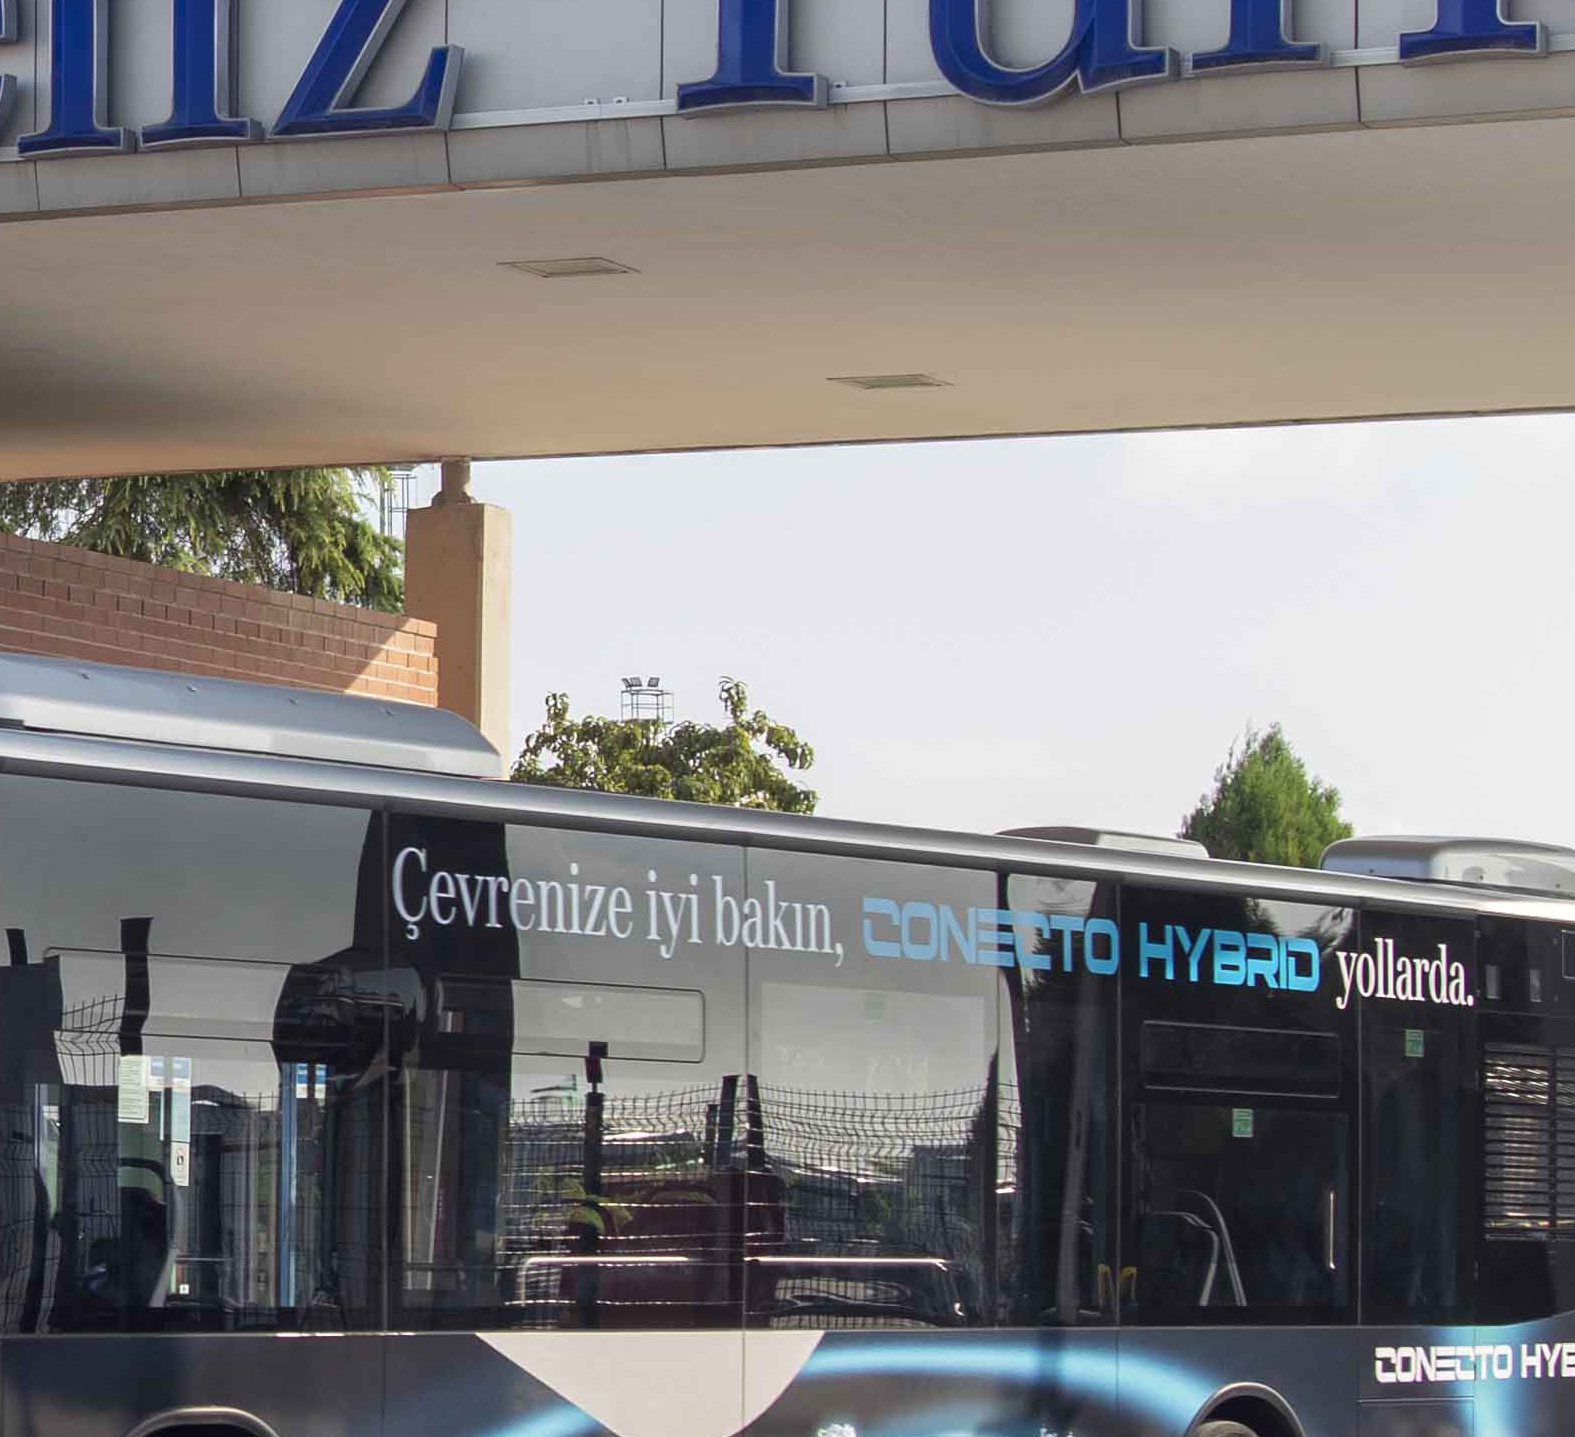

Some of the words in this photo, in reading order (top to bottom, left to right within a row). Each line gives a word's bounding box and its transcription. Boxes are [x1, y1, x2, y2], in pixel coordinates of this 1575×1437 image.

[392, 847, 633, 939] Çevrenize
[645, 870, 700, 959] iyi
[712, 875, 845, 967] bakın,
[863, 897, 1119, 975] CONECTO
[1139, 922, 1319, 992] HYBRID
[1335, 938, 1475, 1010] yollarda.
[1375, 1344, 1513, 1383] CONECTO
